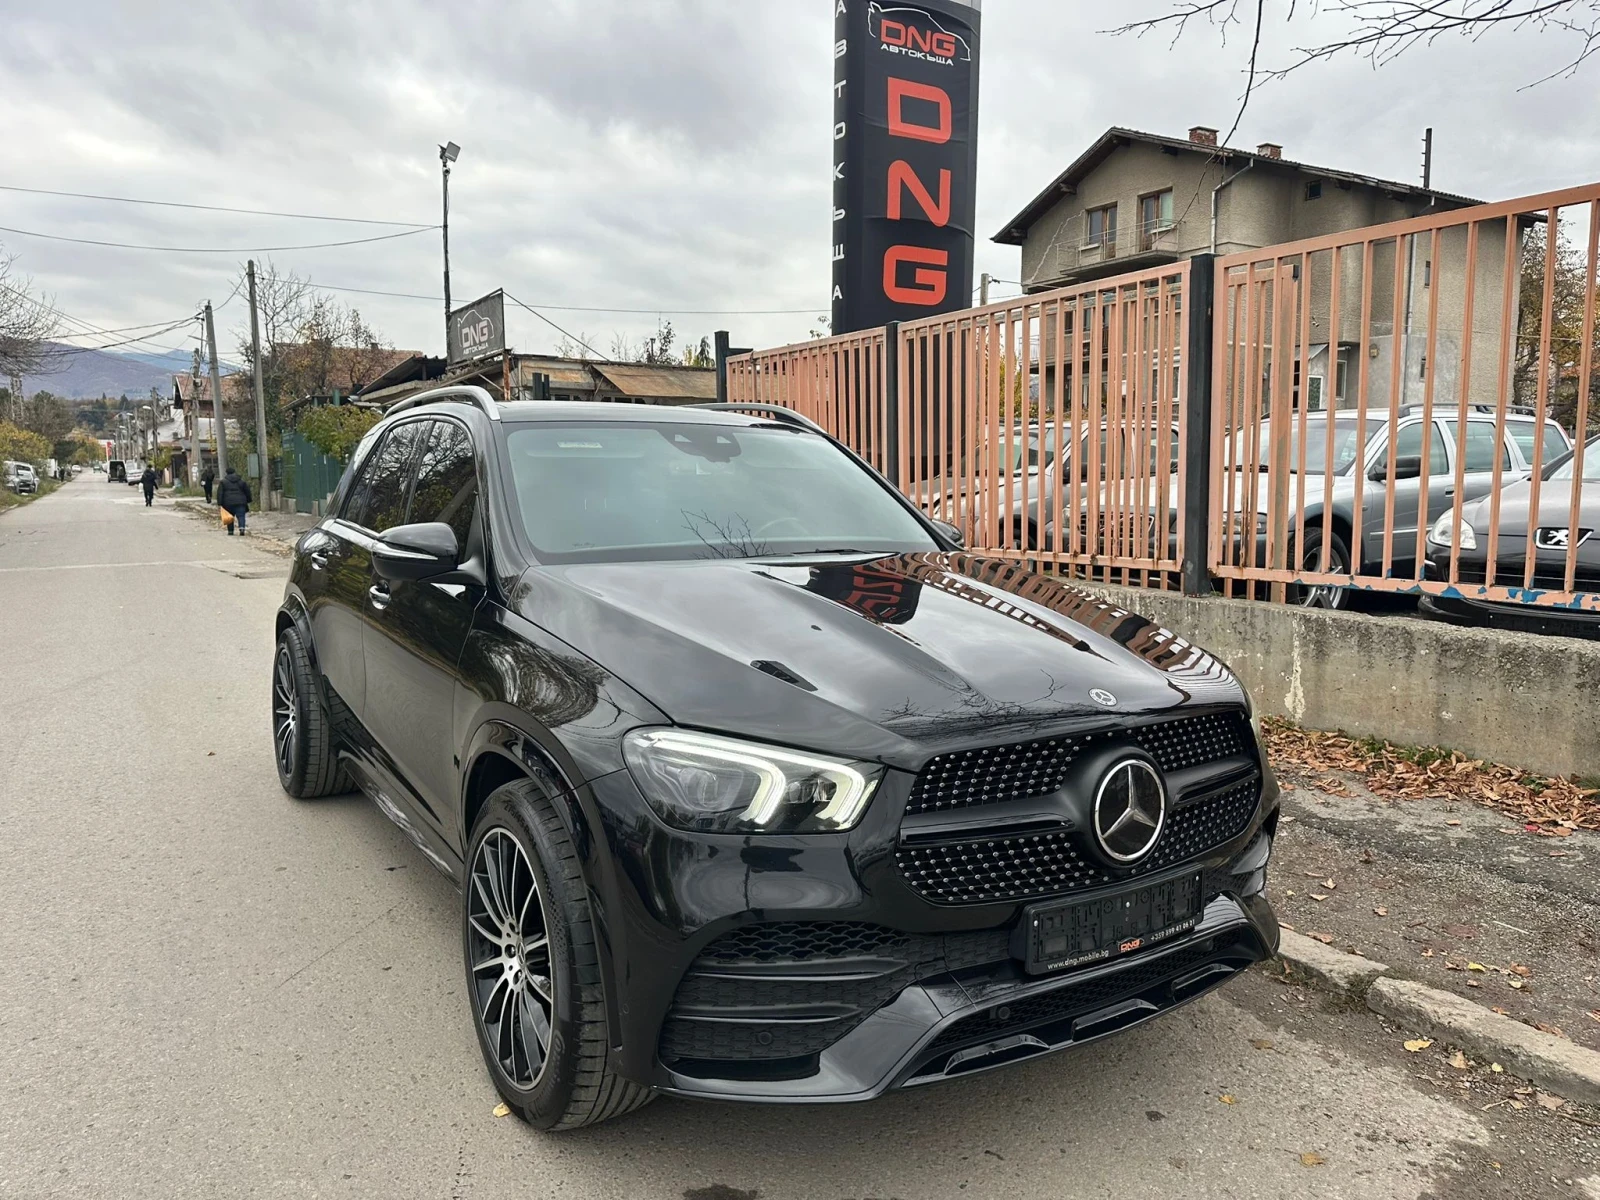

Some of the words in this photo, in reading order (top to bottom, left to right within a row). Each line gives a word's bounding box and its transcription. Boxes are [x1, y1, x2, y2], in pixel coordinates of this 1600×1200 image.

[881, 18, 956, 58] DNG
[883, 76, 952, 306] DNG
[461, 320, 488, 348] DNG
[1120, 938, 1140, 951] DNG
[1047, 949, 1109, 970] www.dng.mobile.bg
